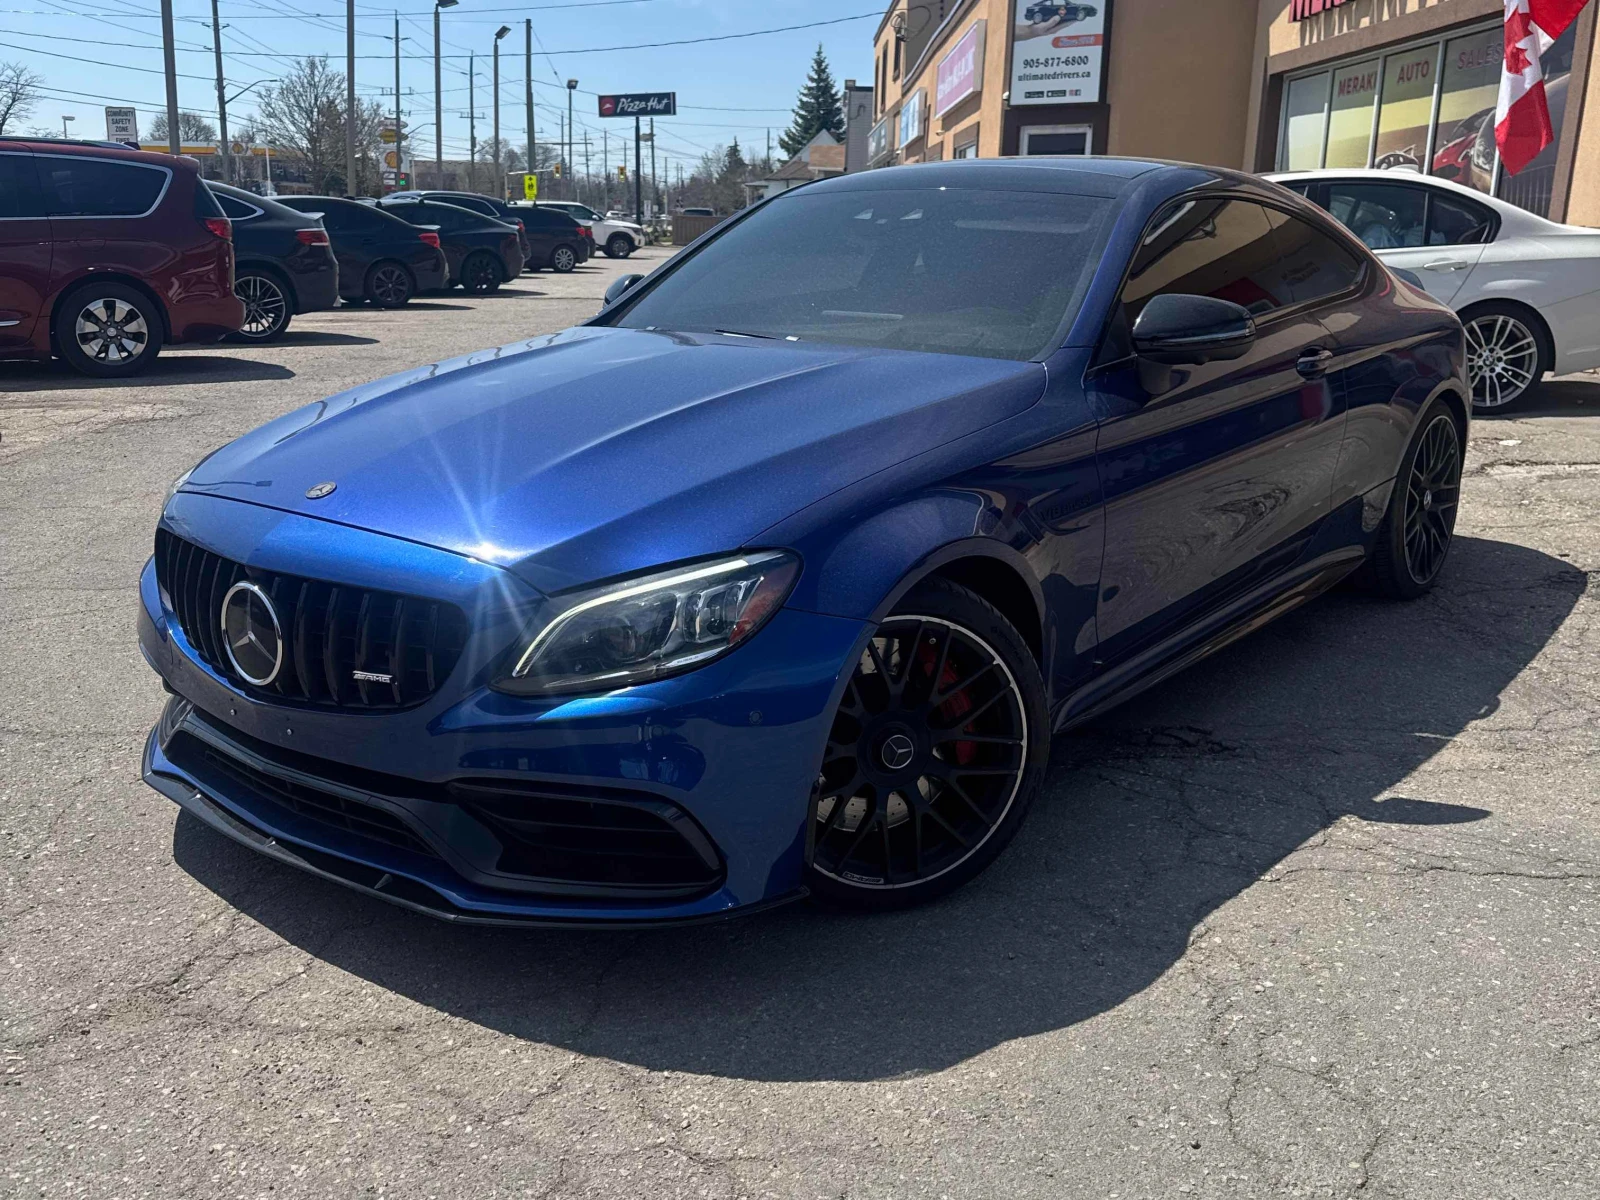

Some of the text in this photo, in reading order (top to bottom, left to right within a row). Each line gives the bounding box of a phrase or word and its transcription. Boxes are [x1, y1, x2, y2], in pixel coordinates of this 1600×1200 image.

[1023, 56, 1089, 68] 905-877-6800
[1018, 71, 1091, 81] ultimatedrivers.ca
[1397, 61, 1430, 84] AUTO
[617, 97, 669, 113] Pizza Hut
